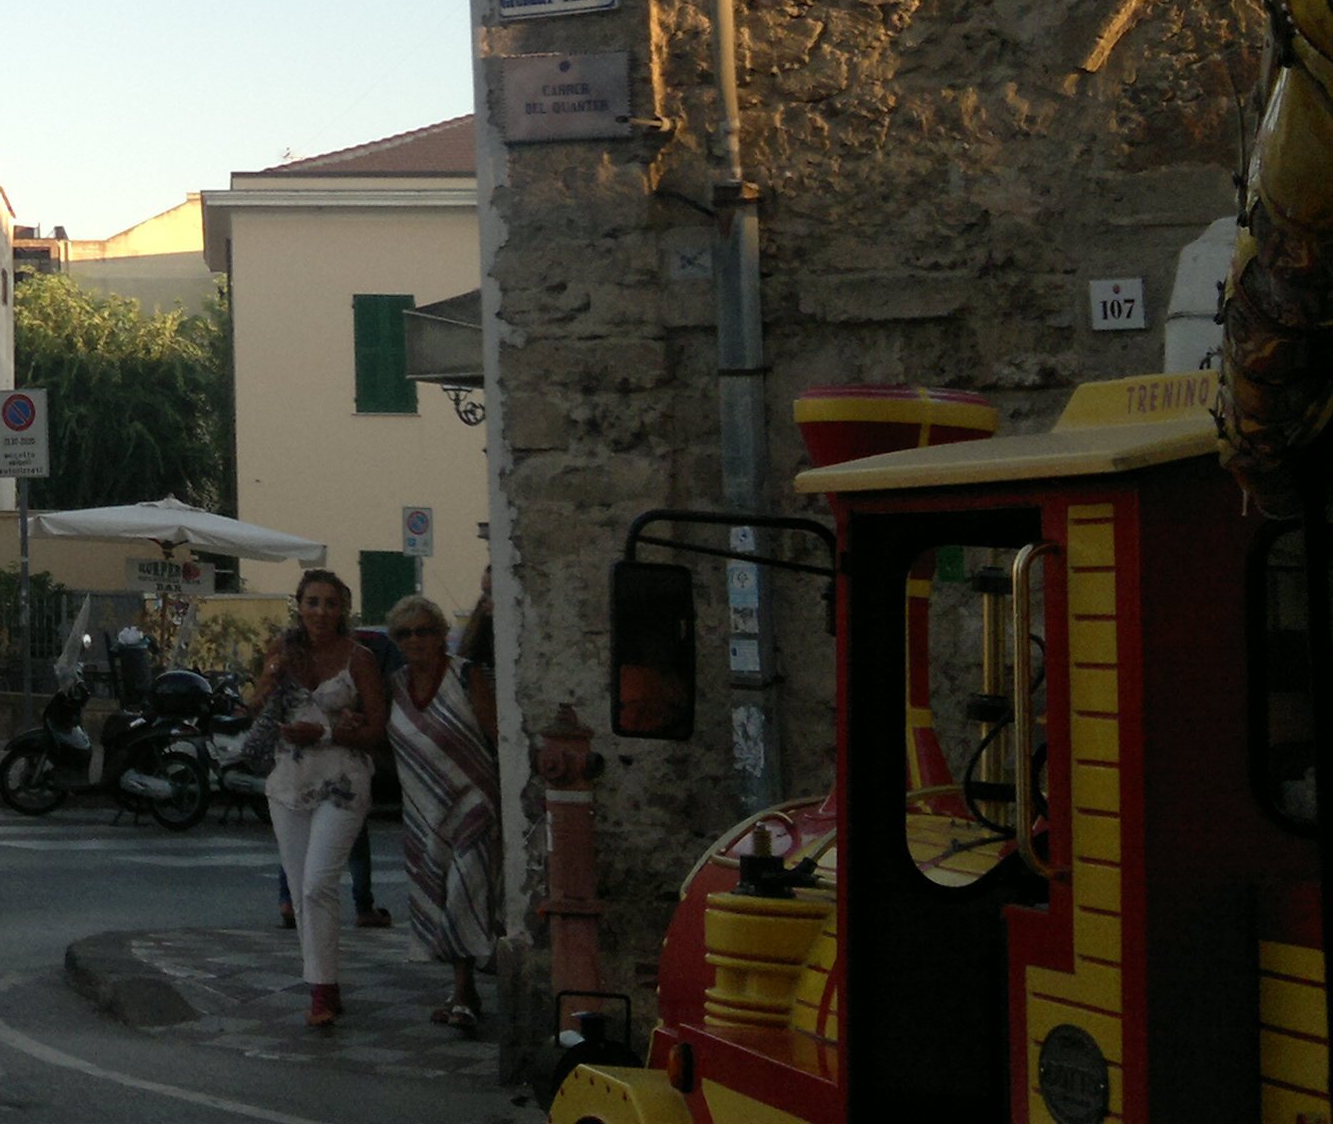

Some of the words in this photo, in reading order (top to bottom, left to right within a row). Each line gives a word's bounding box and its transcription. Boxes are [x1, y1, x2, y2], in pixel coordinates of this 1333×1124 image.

[541, 82, 590, 97] CARRER
[524, 101, 547, 115] DEL
[1100, 298, 1135, 320] 107
[1126, 377, 1210, 414] TRENINO
[156, 583, 182, 592] BAR
